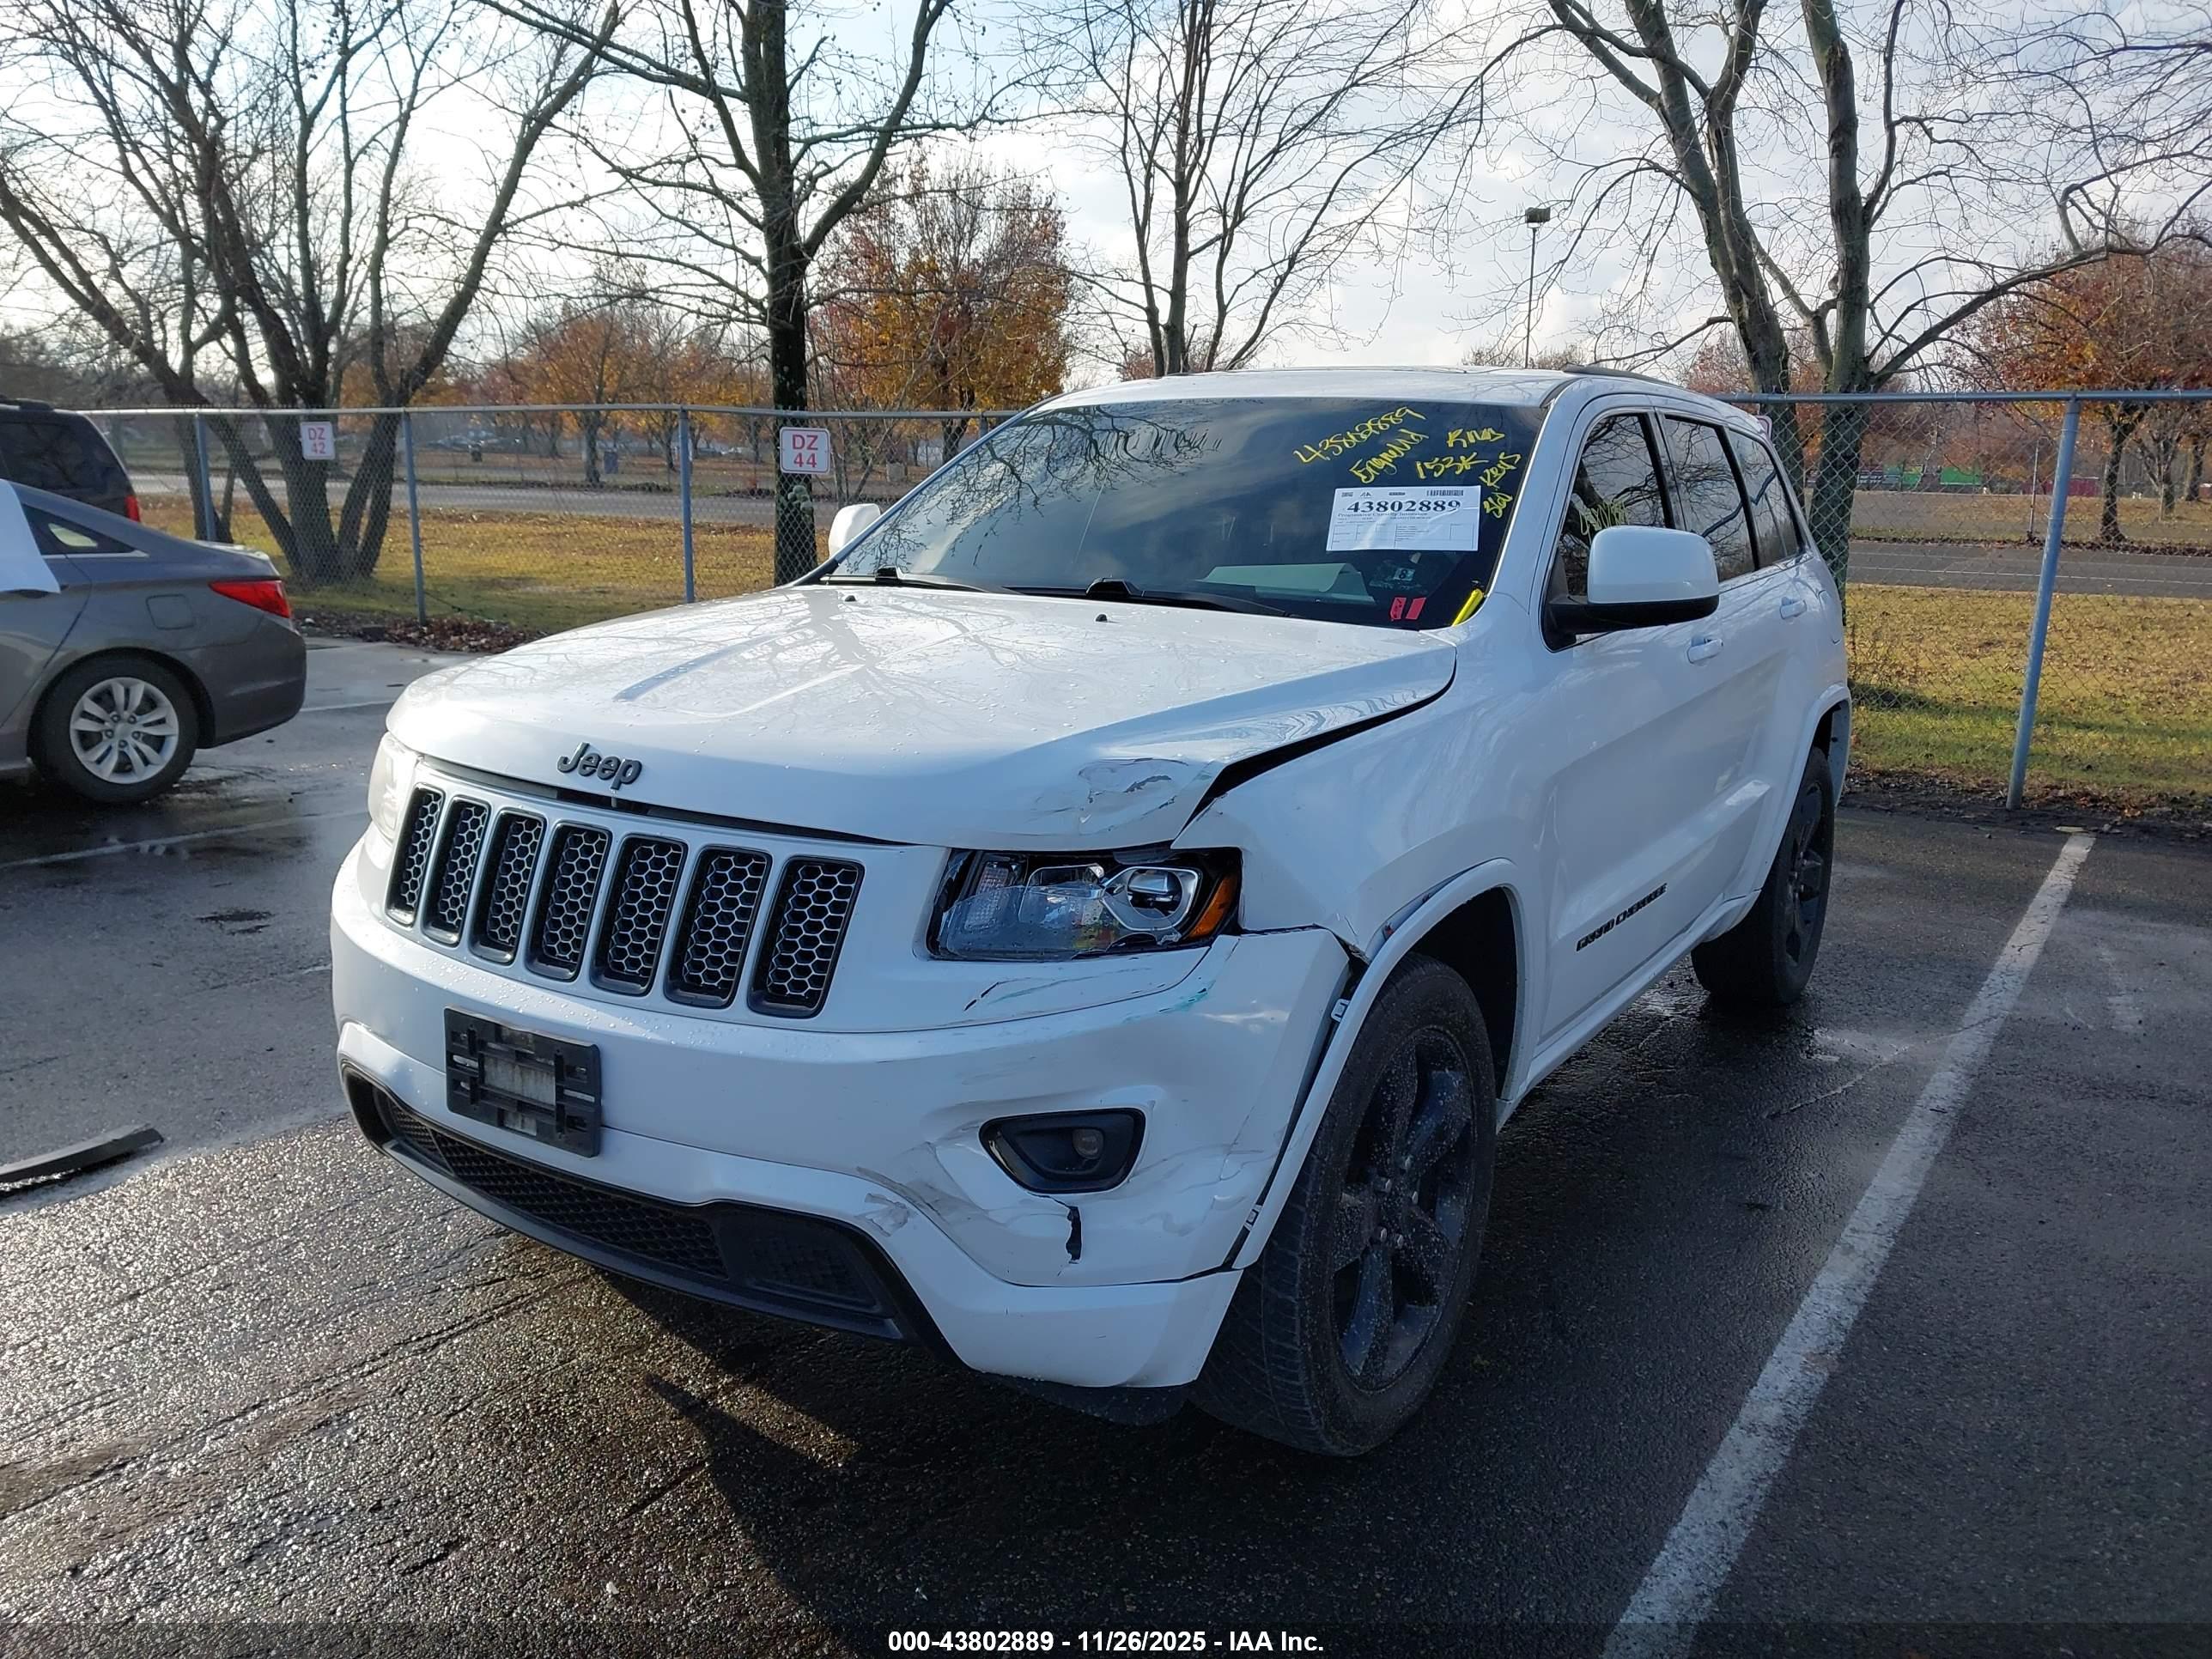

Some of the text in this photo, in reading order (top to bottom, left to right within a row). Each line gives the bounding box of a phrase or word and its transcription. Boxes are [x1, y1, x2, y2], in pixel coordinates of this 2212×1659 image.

[307, 428, 325, 441] DZ
[792, 434, 818, 450] DZ
[793, 453, 817, 468] 44
[1346, 501, 1462, 514] 43802889
[556, 742, 642, 790] Jeep
